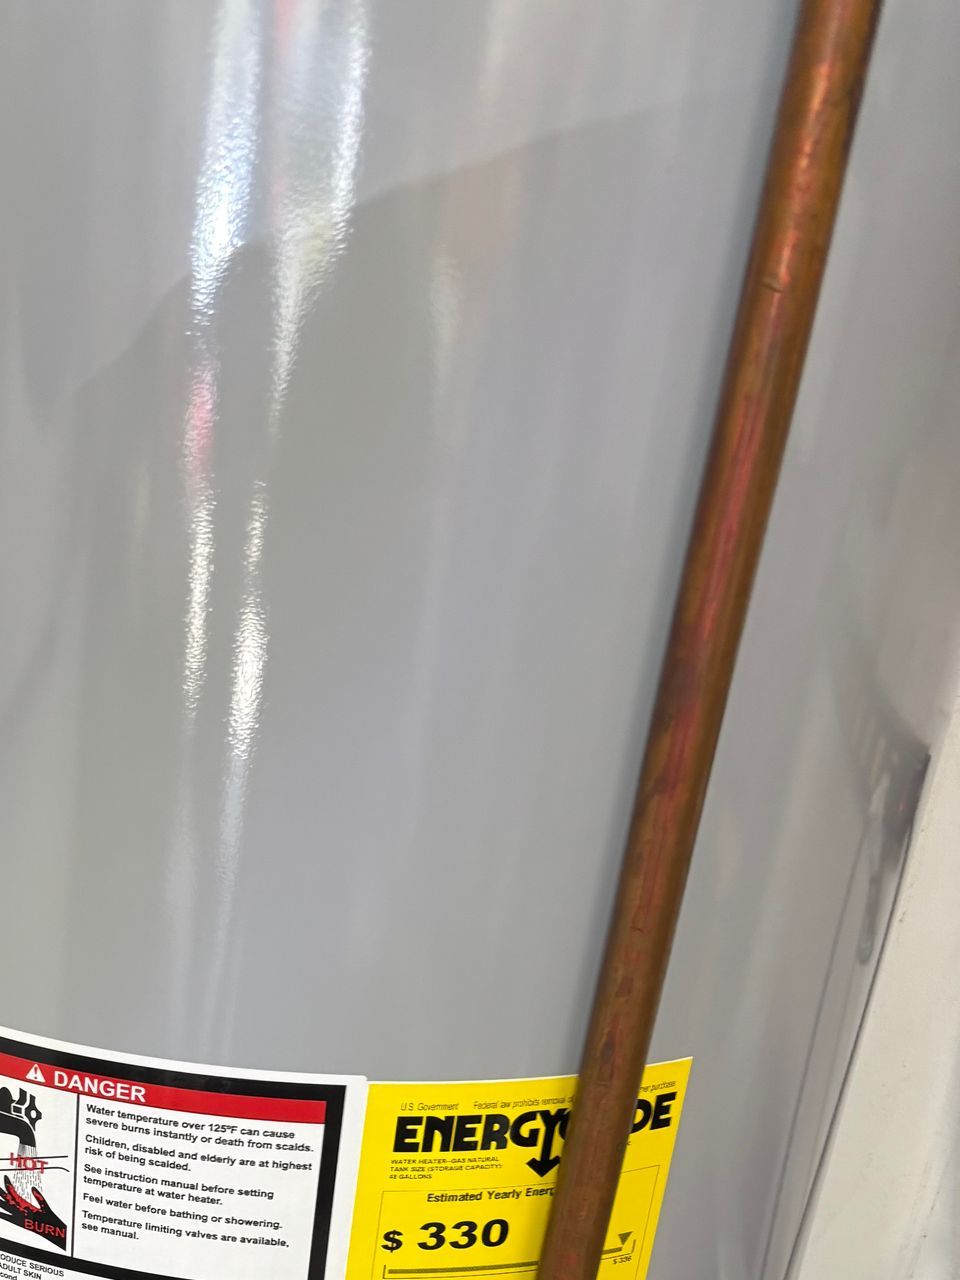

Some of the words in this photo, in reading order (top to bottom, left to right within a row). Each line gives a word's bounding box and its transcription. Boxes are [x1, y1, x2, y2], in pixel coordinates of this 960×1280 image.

[54, 1070, 147, 1103] DANGER
[85, 1117, 119, 1130] severe
[121, 1122, 151, 1135] burns
[153, 1127, 199, 1144] instantly
[200, 1136, 213, 1144] or
[214, 1136, 245, 1147] death
[247, 1139, 273, 1150] from
[275, 1142, 314, 1152] scalds.
[86, 1103, 116, 1117] Water
[117, 1110, 180, 1128] temperature
[181, 1121, 206, 1131] over
[207, 1123, 238, 1134] 125°F
[240, 1128, 260, 1137] can
[262, 1130, 296, 1140] cause
[10, 1152, 48, 1174] HOT
[84, 1146, 103, 1157] risk
[105, 1150, 116, 1159] of
[117, 1151, 146, 1167] being
[147, 1159, 191, 1172] scalded.
[85, 1133, 130, 1151] Children,
[131, 1143, 176, 1158] disabled
[177, 1151, 198, 1161] and
[200, 1153, 237, 1167] elderly
[238, 1158, 256, 1167] are
[258, 1160, 270, 1168] at
[271, 1160, 313, 1172] highest
[83, 1163, 103, 1175] See
[104, 1167, 159, 1185] instruction
[160, 1179, 199, 1191] manual
[201, 1183, 235, 1195] before
[237, 1188, 275, 1201] setting
[83, 1175, 143, 1194] temperature
[144, 1188, 155, 1197] at
[156, 1190, 186, 1201] water
[187, 1192, 223, 1206] heater.
[426, 1191, 483, 1203] Estimated
[486, 1188, 523, 1200] Yearly
[525, 1185, 556, 1200] Ener
[82, 1192, 103, 1204] Feel
[105, 1199, 133, 1210] water
[134, 1202, 167, 1216] before
[169, 1208, 209, 1224] bathing
[210, 1215, 223, 1223] or
[224, 1216, 283, 1231] showering.
[24, 1219, 65, 1238] BURN
[81, 1209, 143, 1230] Temperature
[144, 1222, 183, 1238] limiting
[184, 1229, 218, 1241] valves
[220, 1234, 238, 1243] are
[239, 1236, 290, 1248] available,
[81, 1222, 99, 1232] see
[100, 1226, 140, 1240] manual.
[381, 1230, 404, 1253] $
[417, 1219, 510, 1251] 330
[23, 1269, 42, 1280] SKIN
[29, 1262, 65, 1278] SERIOUS
